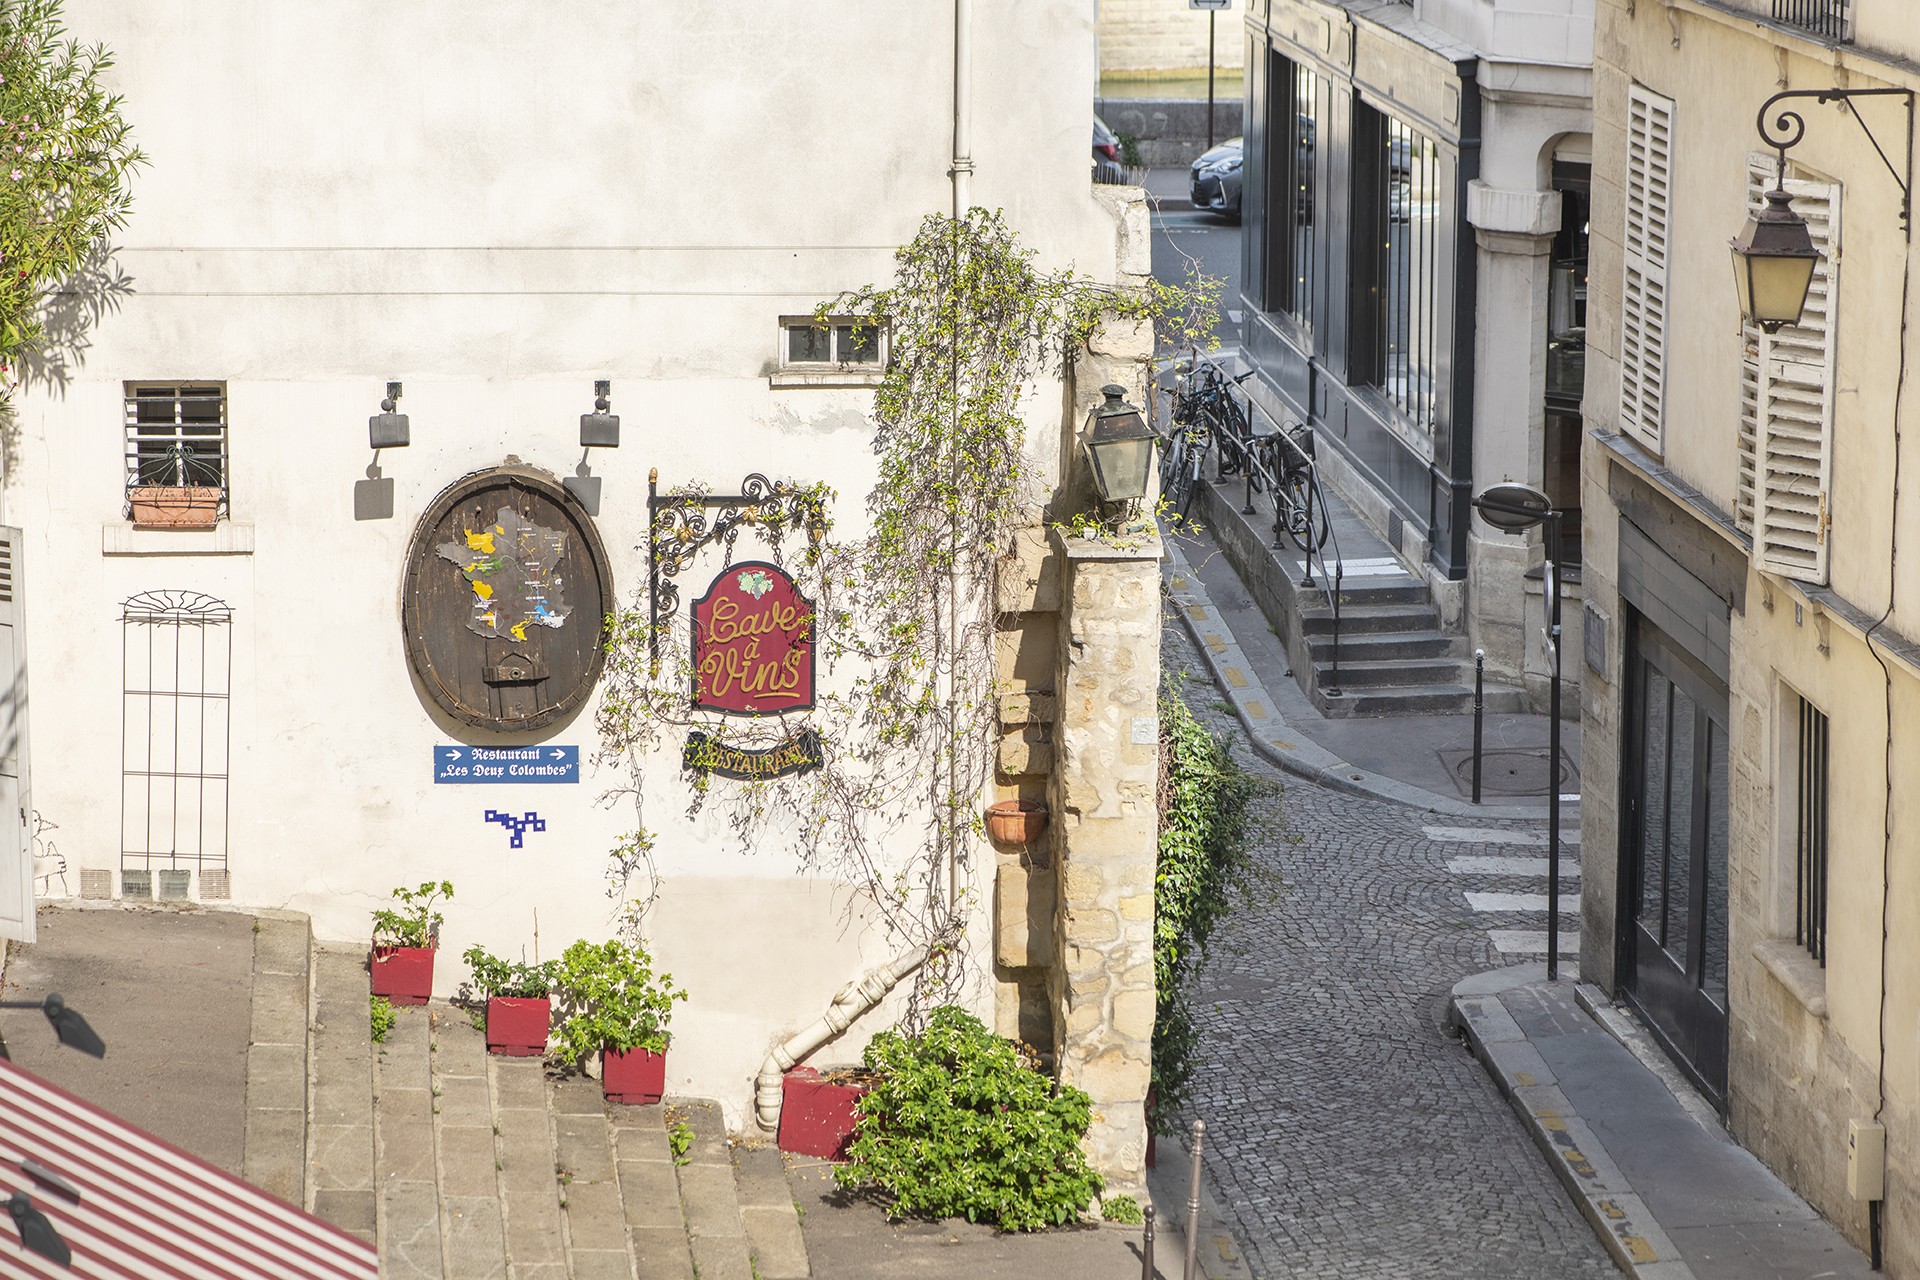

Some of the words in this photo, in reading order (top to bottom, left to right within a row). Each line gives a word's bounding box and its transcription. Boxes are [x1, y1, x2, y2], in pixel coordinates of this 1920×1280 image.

[704, 596, 802, 644] Cave
[743, 635, 760, 660] à
[700, 647, 806, 698] Vins
[471, 748, 540, 760] Restaurant
[472, 764, 504, 778] Deux
